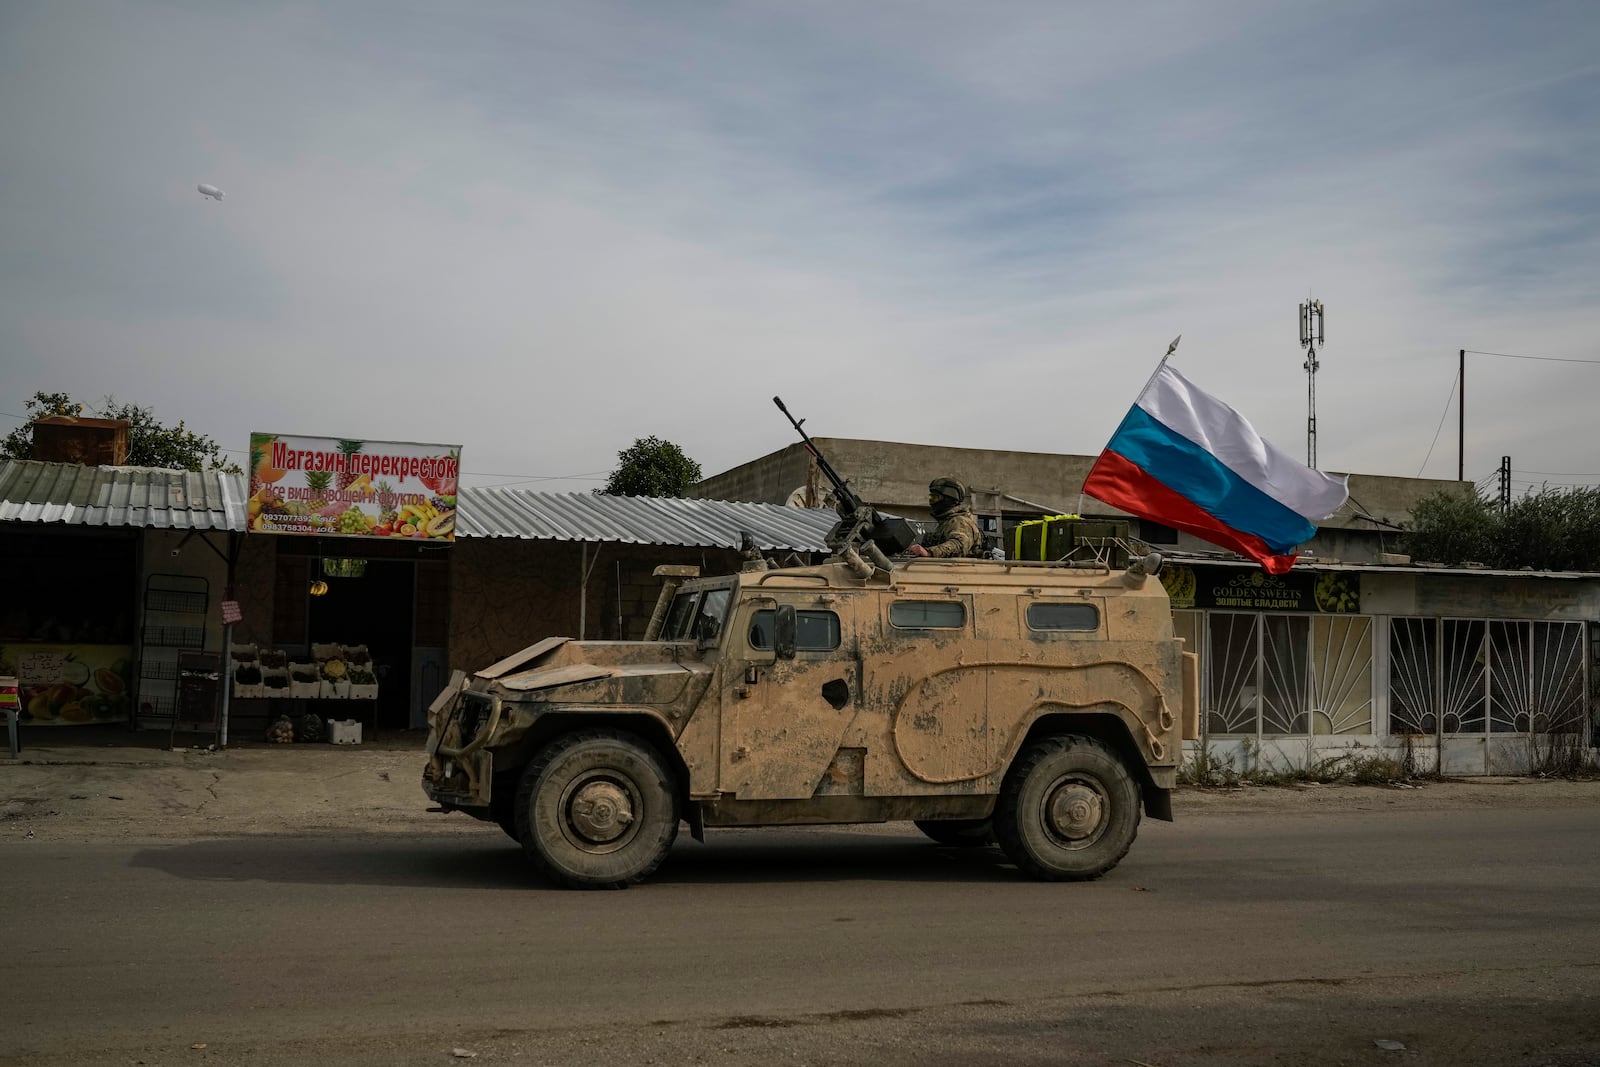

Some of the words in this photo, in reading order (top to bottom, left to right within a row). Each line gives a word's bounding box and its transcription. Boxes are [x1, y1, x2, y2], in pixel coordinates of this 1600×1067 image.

[272, 441, 347, 472] Магазин
[350, 453, 456, 483] перекресток
[265, 482, 285, 499] Все
[288, 486, 320, 503] виды
[321, 486, 365, 506] овощей
[366, 491, 376, 503] и
[378, 490, 426, 511] фруктов
[1213, 587, 1257, 597] GOLDEN
[1260, 589, 1302, 599] SWEETS
[1216, 598, 1252, 606] ЗОЛОТЫЕ
[1254, 600, 1298, 608] СЛАДОСТИ
